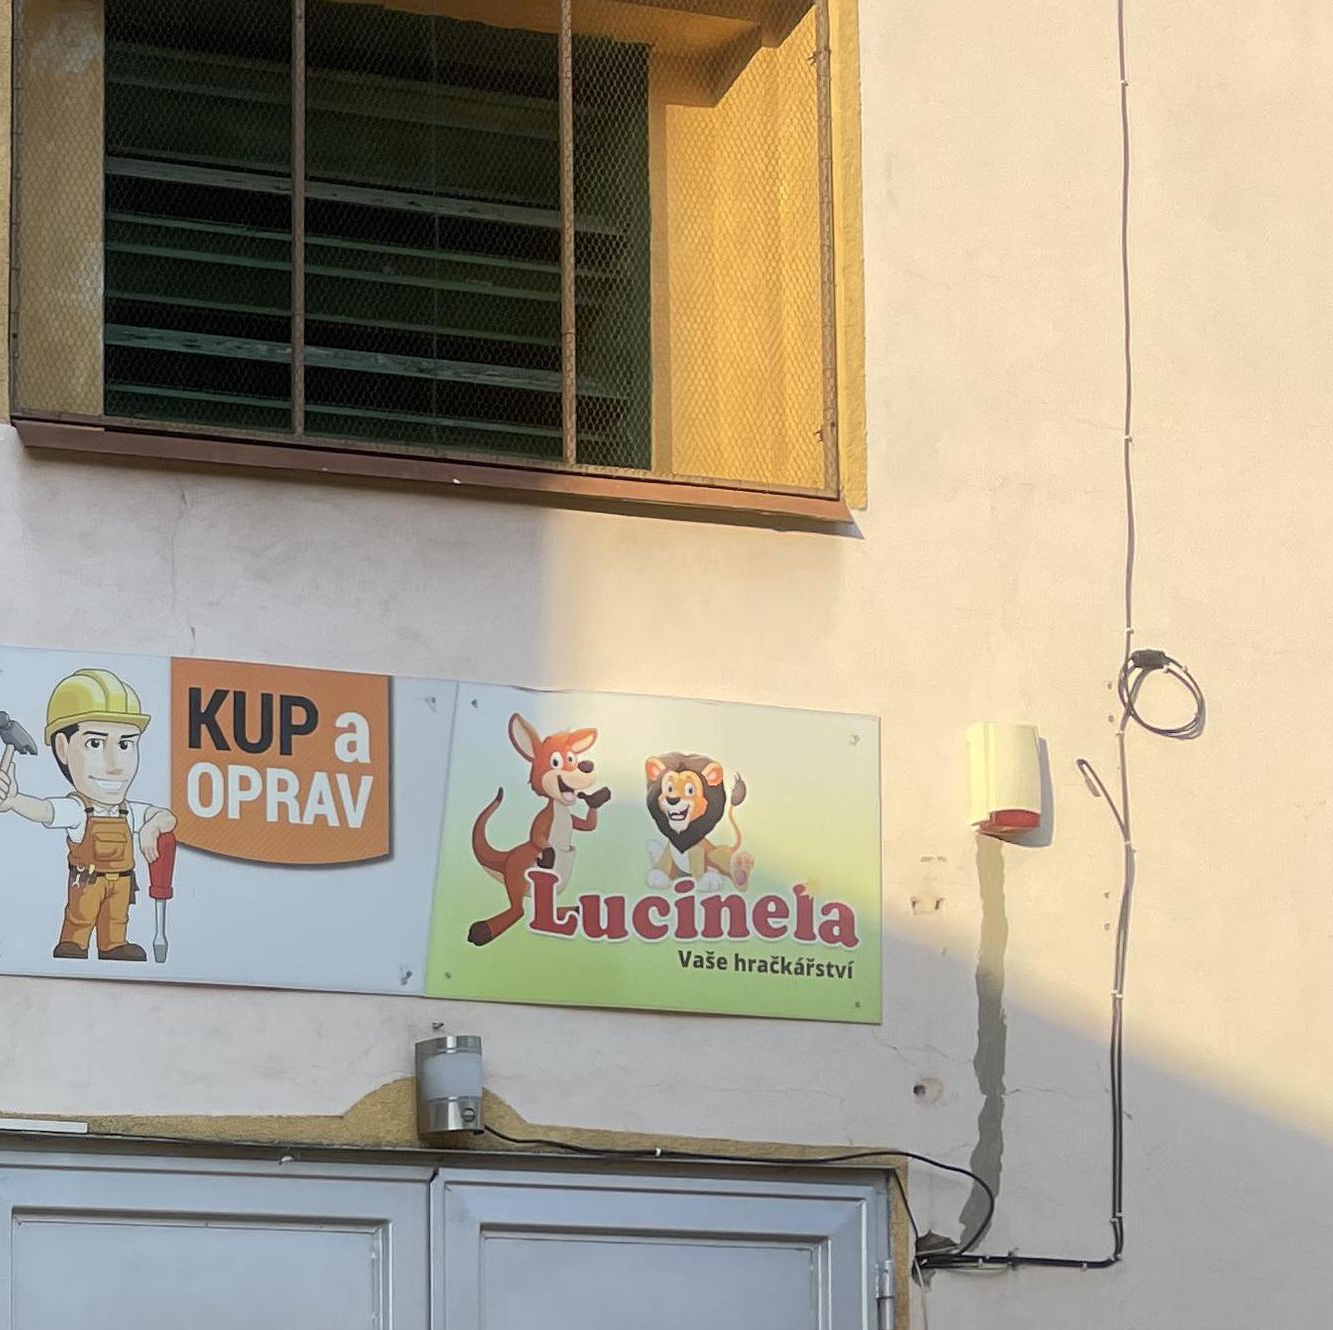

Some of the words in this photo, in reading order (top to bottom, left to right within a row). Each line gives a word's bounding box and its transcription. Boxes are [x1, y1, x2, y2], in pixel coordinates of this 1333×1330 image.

[188, 687, 319, 756] KUP
[334, 712, 371, 764] a
[187, 761, 374, 829] OPRAV
[527, 870, 859, 948] Lucinela
[677, 950, 728, 971] Vaše
[734, 953, 855, 979] hračkářství
